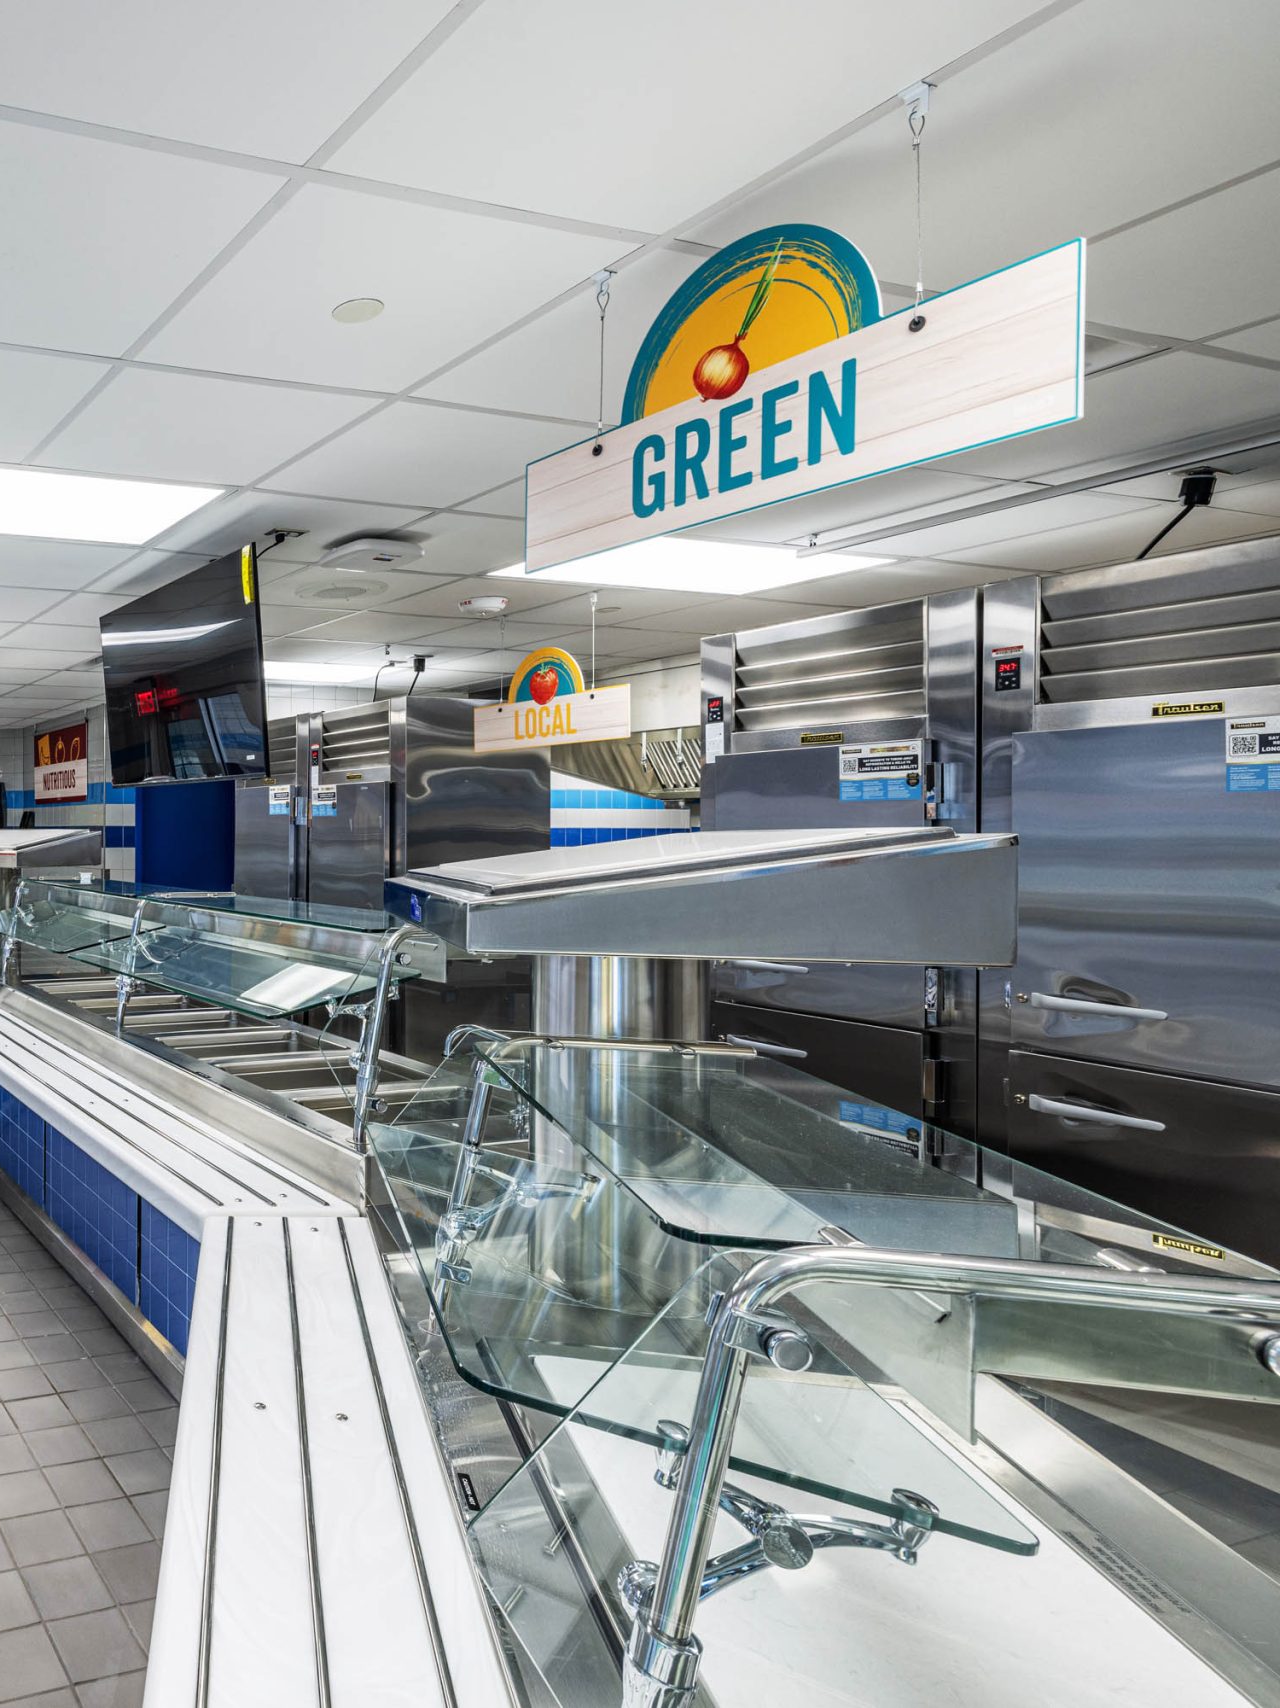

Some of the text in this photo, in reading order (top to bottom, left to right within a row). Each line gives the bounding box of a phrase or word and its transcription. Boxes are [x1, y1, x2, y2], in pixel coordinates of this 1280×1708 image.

[632, 358, 857, 518] GREEN
[514, 703, 577, 740] LOCAL
[1153, 702, 1220, 715] Traulsen
[43, 769, 76, 792] NUTRITIOUS
